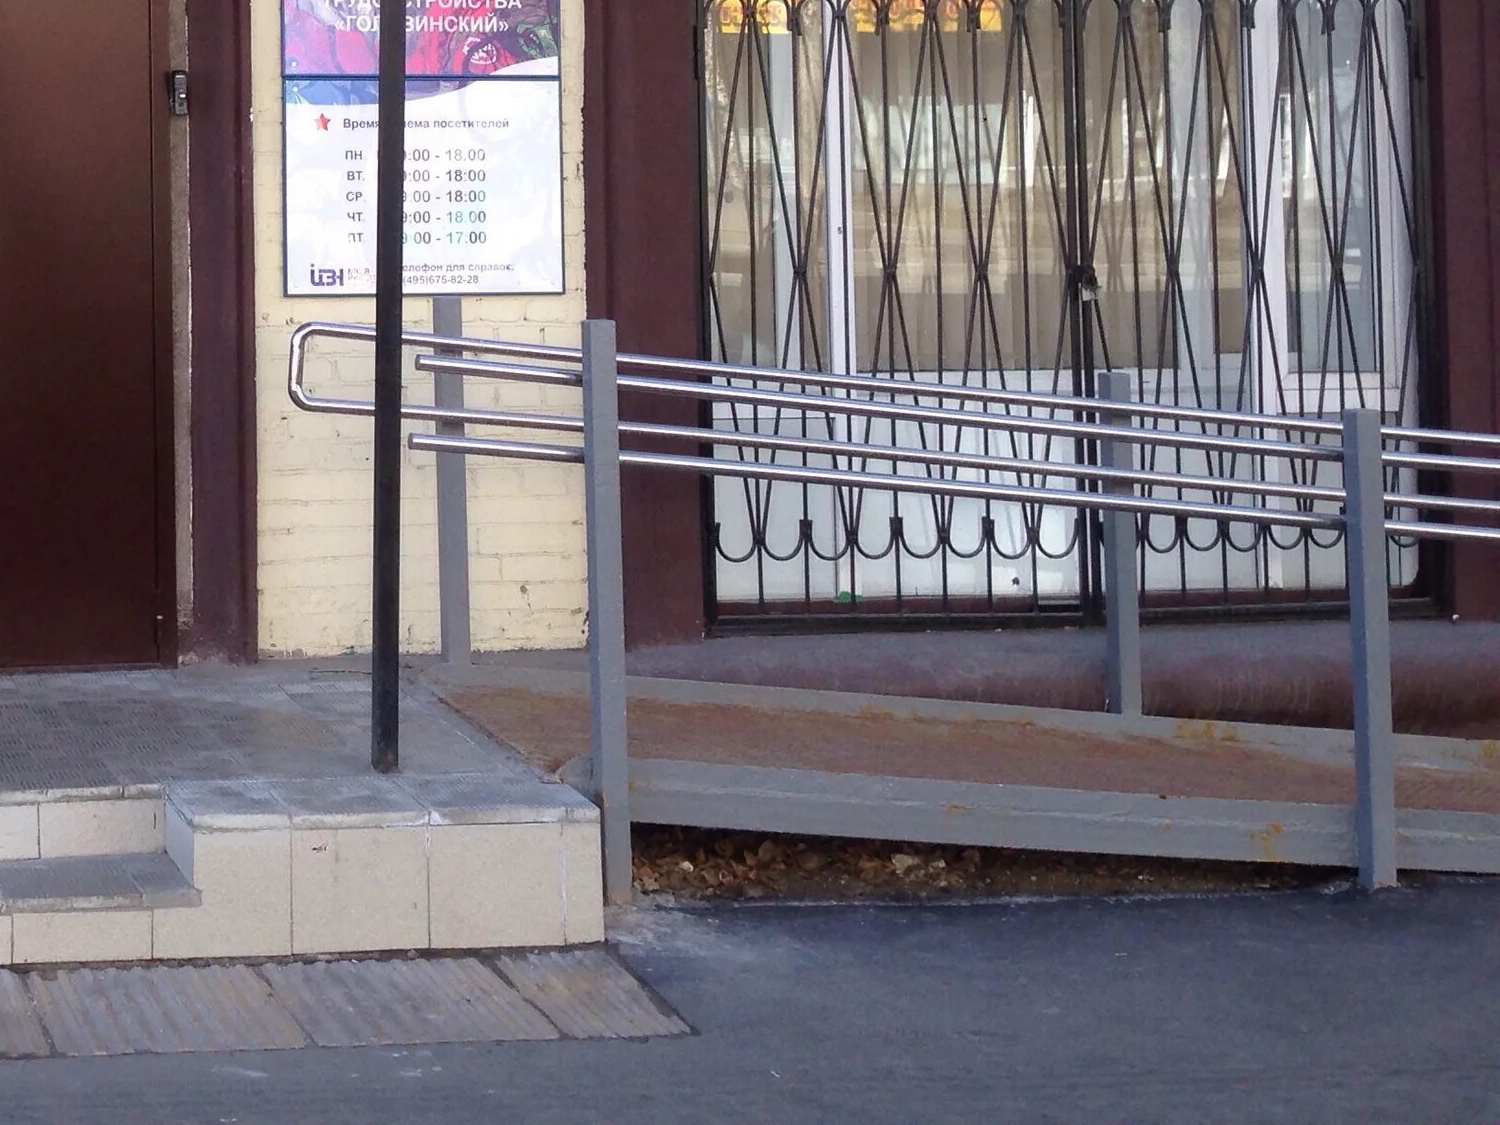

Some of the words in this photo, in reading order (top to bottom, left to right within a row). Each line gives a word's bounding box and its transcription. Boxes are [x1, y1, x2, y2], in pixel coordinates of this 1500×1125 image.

[433, 118, 510, 129] посетителей
[445, 169, 487, 182] 18:00
[446, 190, 487, 203] 18:00
[402, 263, 443, 273] елефон
[445, 264, 465, 272] для
